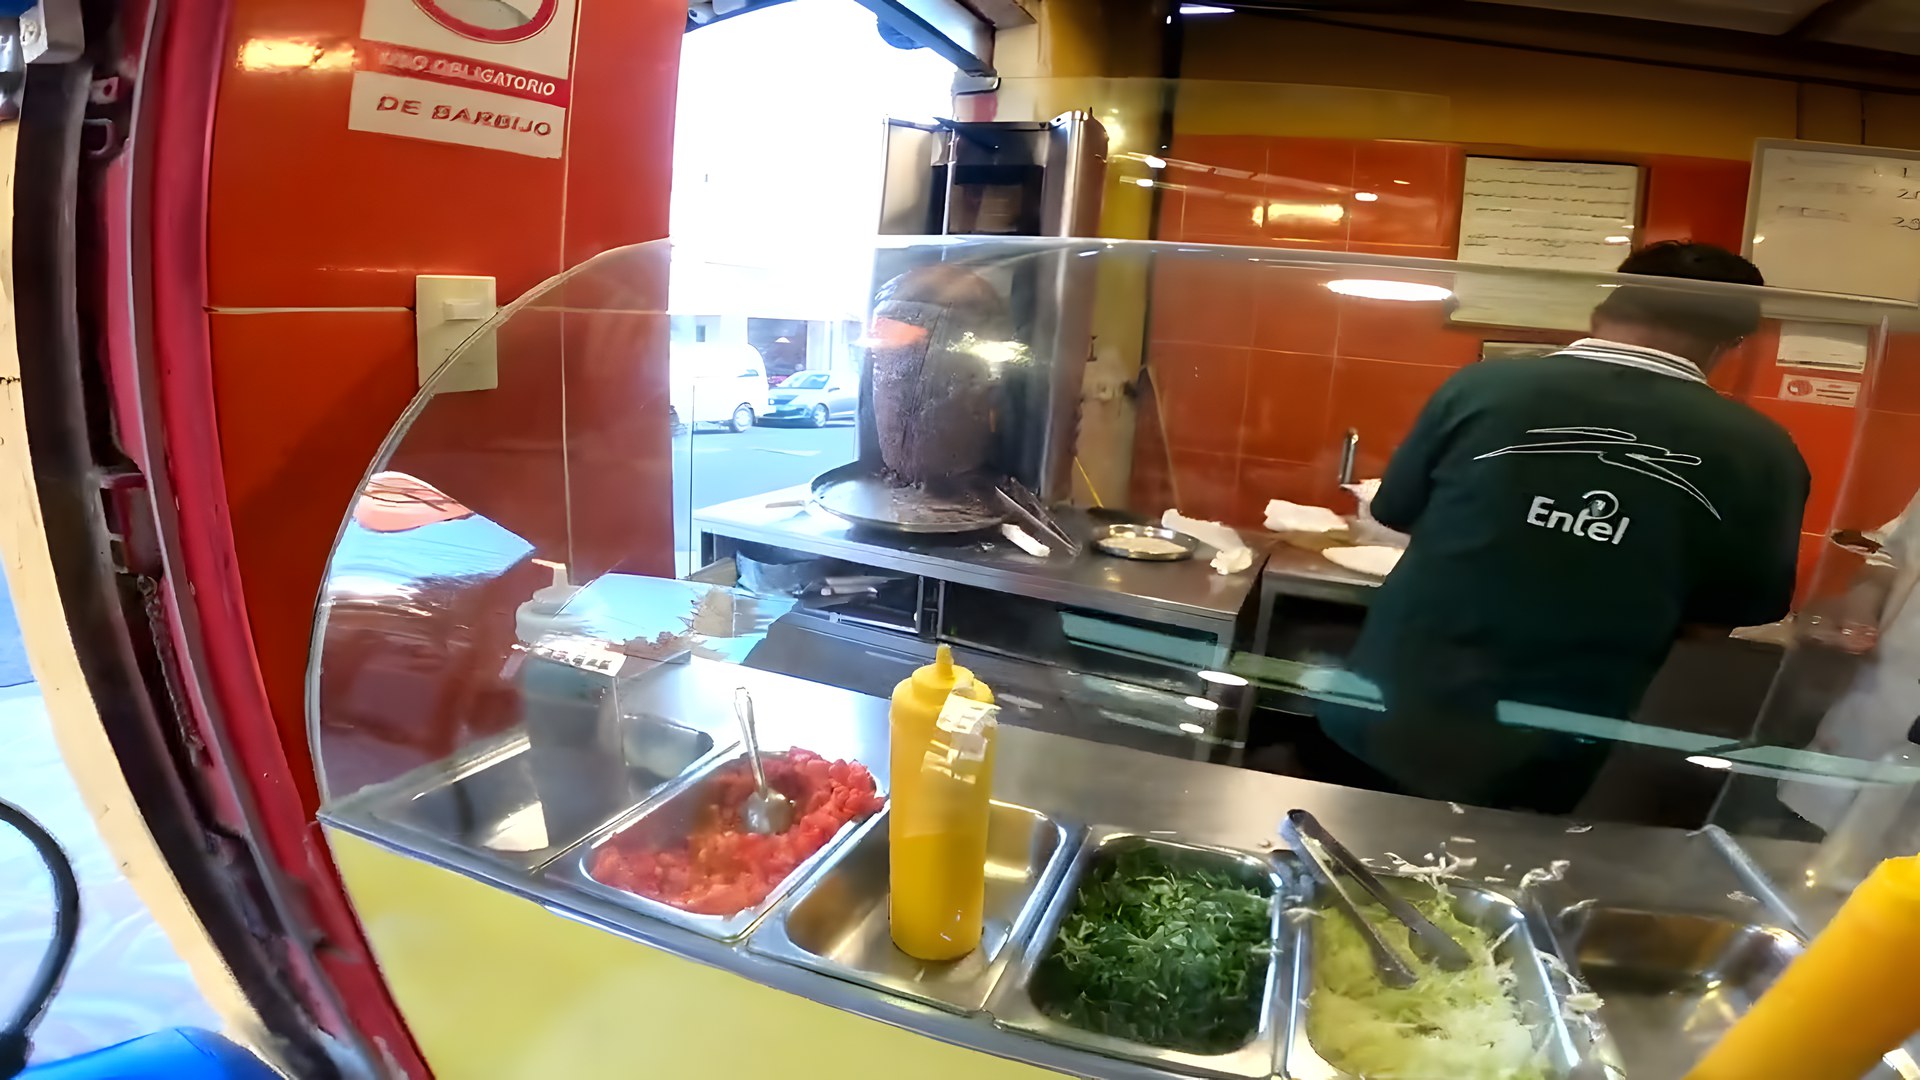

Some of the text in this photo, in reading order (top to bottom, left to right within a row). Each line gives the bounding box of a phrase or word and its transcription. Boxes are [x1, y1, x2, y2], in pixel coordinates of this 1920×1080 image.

[432, 57, 556, 97] OBLIGATORIO
[376, 95, 553, 137] DE BARBIJO
[1527, 490, 1630, 545] Entel
